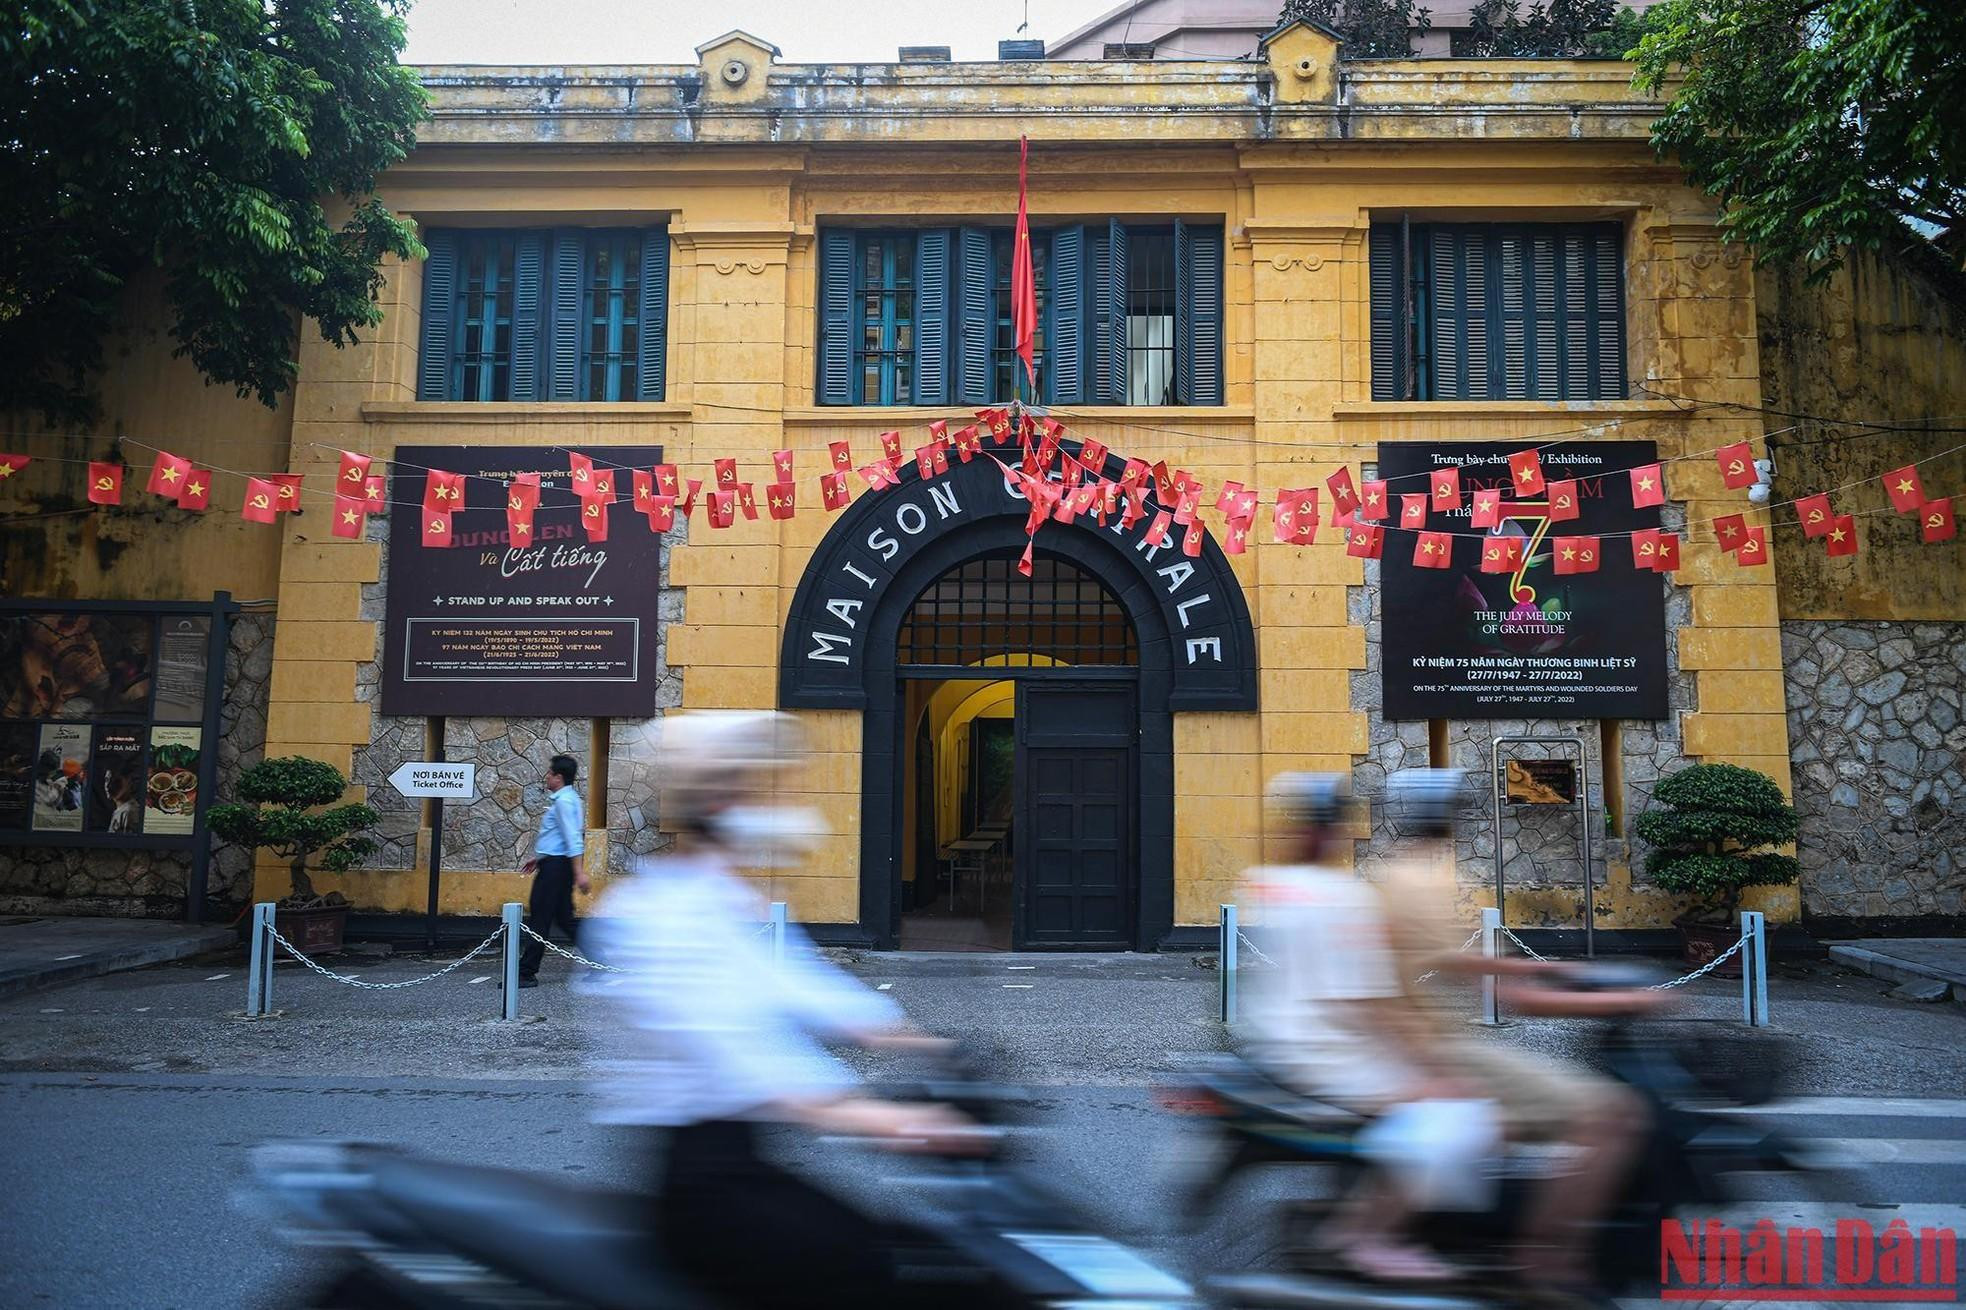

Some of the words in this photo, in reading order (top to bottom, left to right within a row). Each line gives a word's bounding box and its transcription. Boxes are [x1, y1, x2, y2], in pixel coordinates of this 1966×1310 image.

[1431, 454, 1464, 466] Trưng
[1466, 454, 1485, 466] bày
[1548, 453, 1602, 465] Exhibition
[479, 552, 499, 566] Và
[501, 546, 547, 577] Cất
[551, 544, 608, 589] tiếng
[807, 481, 963, 665] MAISON
[448, 596, 485, 606] STAND
[489, 596, 504, 606] UP
[507, 596, 533, 606] AND
[536, 596, 572, 606] SPEAK
[575, 596, 600, 606] OUT
[1473, 611, 1498, 621] THE
[1499, 611, 1524, 623] JULY
[1526, 611, 1572, 621] MELODY
[1482, 624, 1498, 634] OF
[1500, 624, 1566, 634] GRATITUDE
[1412, 656, 1426, 667] KỶ
[1428, 656, 1454, 669] NIỆM
[1456, 658, 1469, 667] 75
[1471, 657, 1495, 667] NĂM
[1497, 656, 1525, 667] NGÀY
[1526, 658, 1572, 667] THƯƠNG
[1573, 658, 1599, 667] BINH
[1600, 656, 1622, 669] LIỆT
[1467, 670, 1521, 681] (27/7/1947
[1529, 670, 1583, 681] 27/7/2022)
[413, 771, 430, 779] NƠI
[432, 771, 452, 779] BÁN
[453, 771, 465, 780] VÉ
